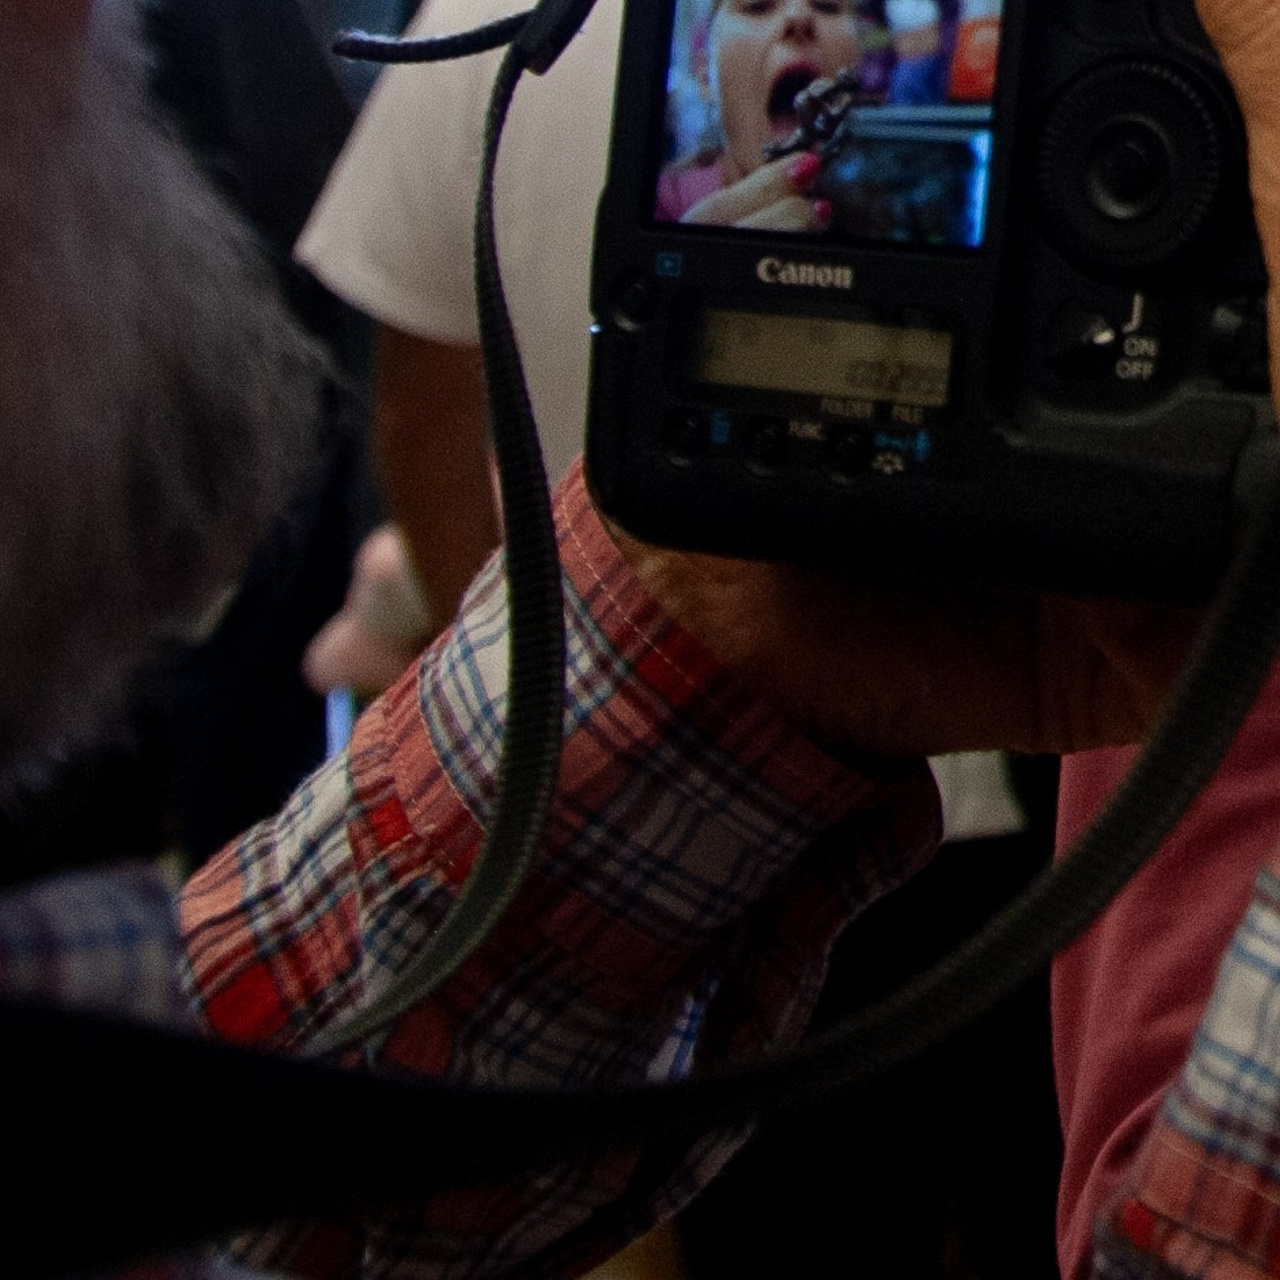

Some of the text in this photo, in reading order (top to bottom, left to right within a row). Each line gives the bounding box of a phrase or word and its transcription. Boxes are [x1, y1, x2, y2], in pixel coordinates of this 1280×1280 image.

[756, 256, 853, 289] Canon
[1122, 336, 1159, 358] ON
[1115, 358, 1155, 381] OFF
